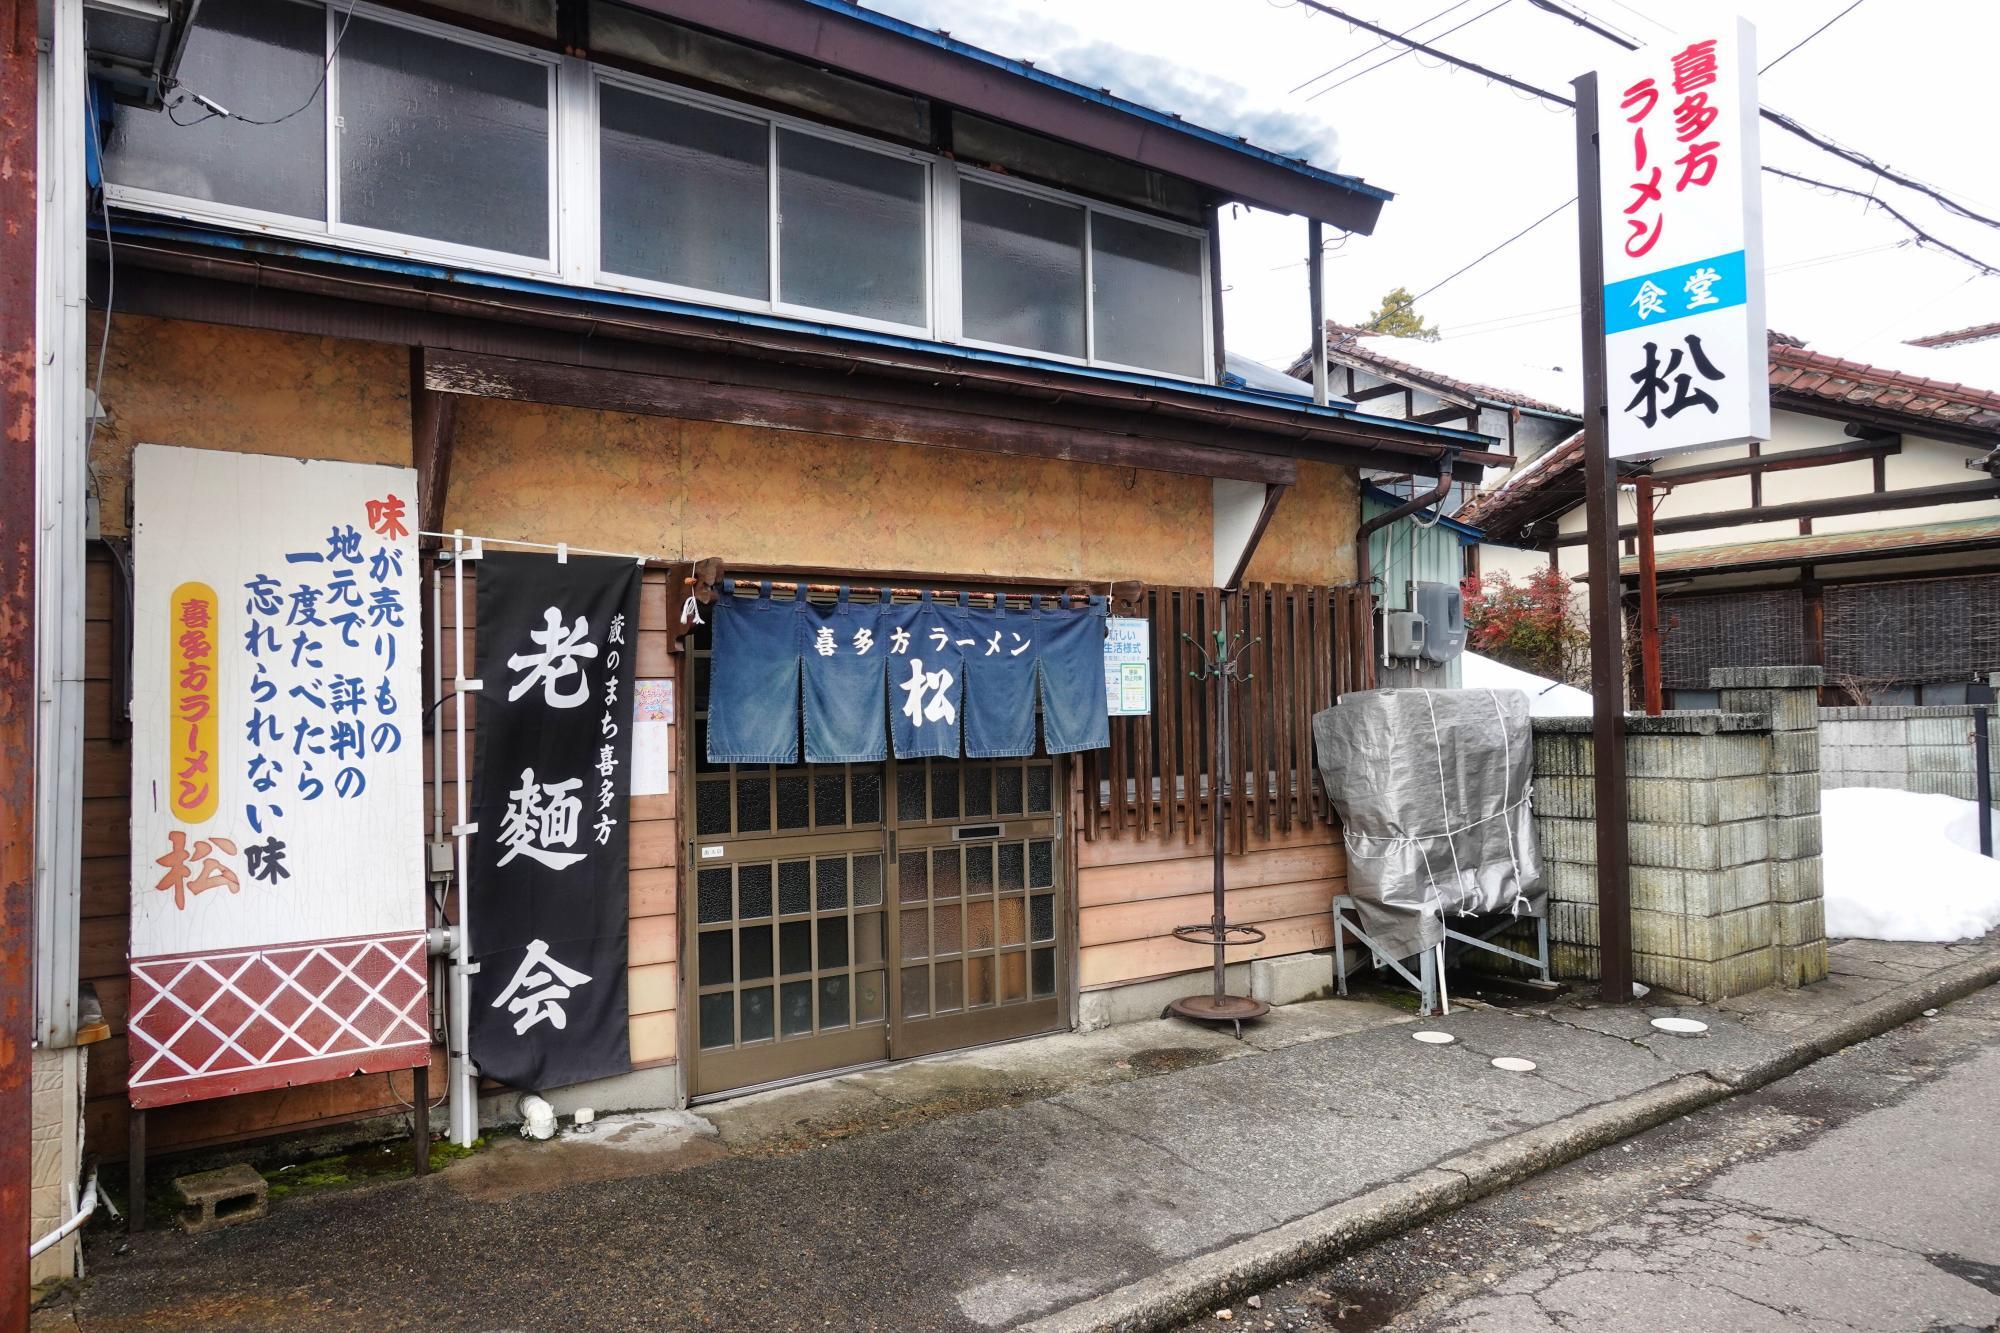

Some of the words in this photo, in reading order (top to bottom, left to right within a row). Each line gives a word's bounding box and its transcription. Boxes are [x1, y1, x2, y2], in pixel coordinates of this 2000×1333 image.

[1620, 78, 1663, 258] ラーメン
[1671, 39, 1720, 192] 喜多方
[1631, 267, 1722, 320] 食堂
[1624, 334, 1726, 428] 松
[178, 599, 212, 810] 喜多方ラーメン
[285, 549, 326, 801] 一度たべたら
[363, 494, 409, 759] 味が売りもの
[814, 626, 1031, 657] 喜多方ラーメン
[900, 658, 957, 727] 松
[245, 573, 290, 884] 忘れられない味
[593, 614, 626, 845] 蔵のまち喜多方
[155, 831, 240, 910] 松
